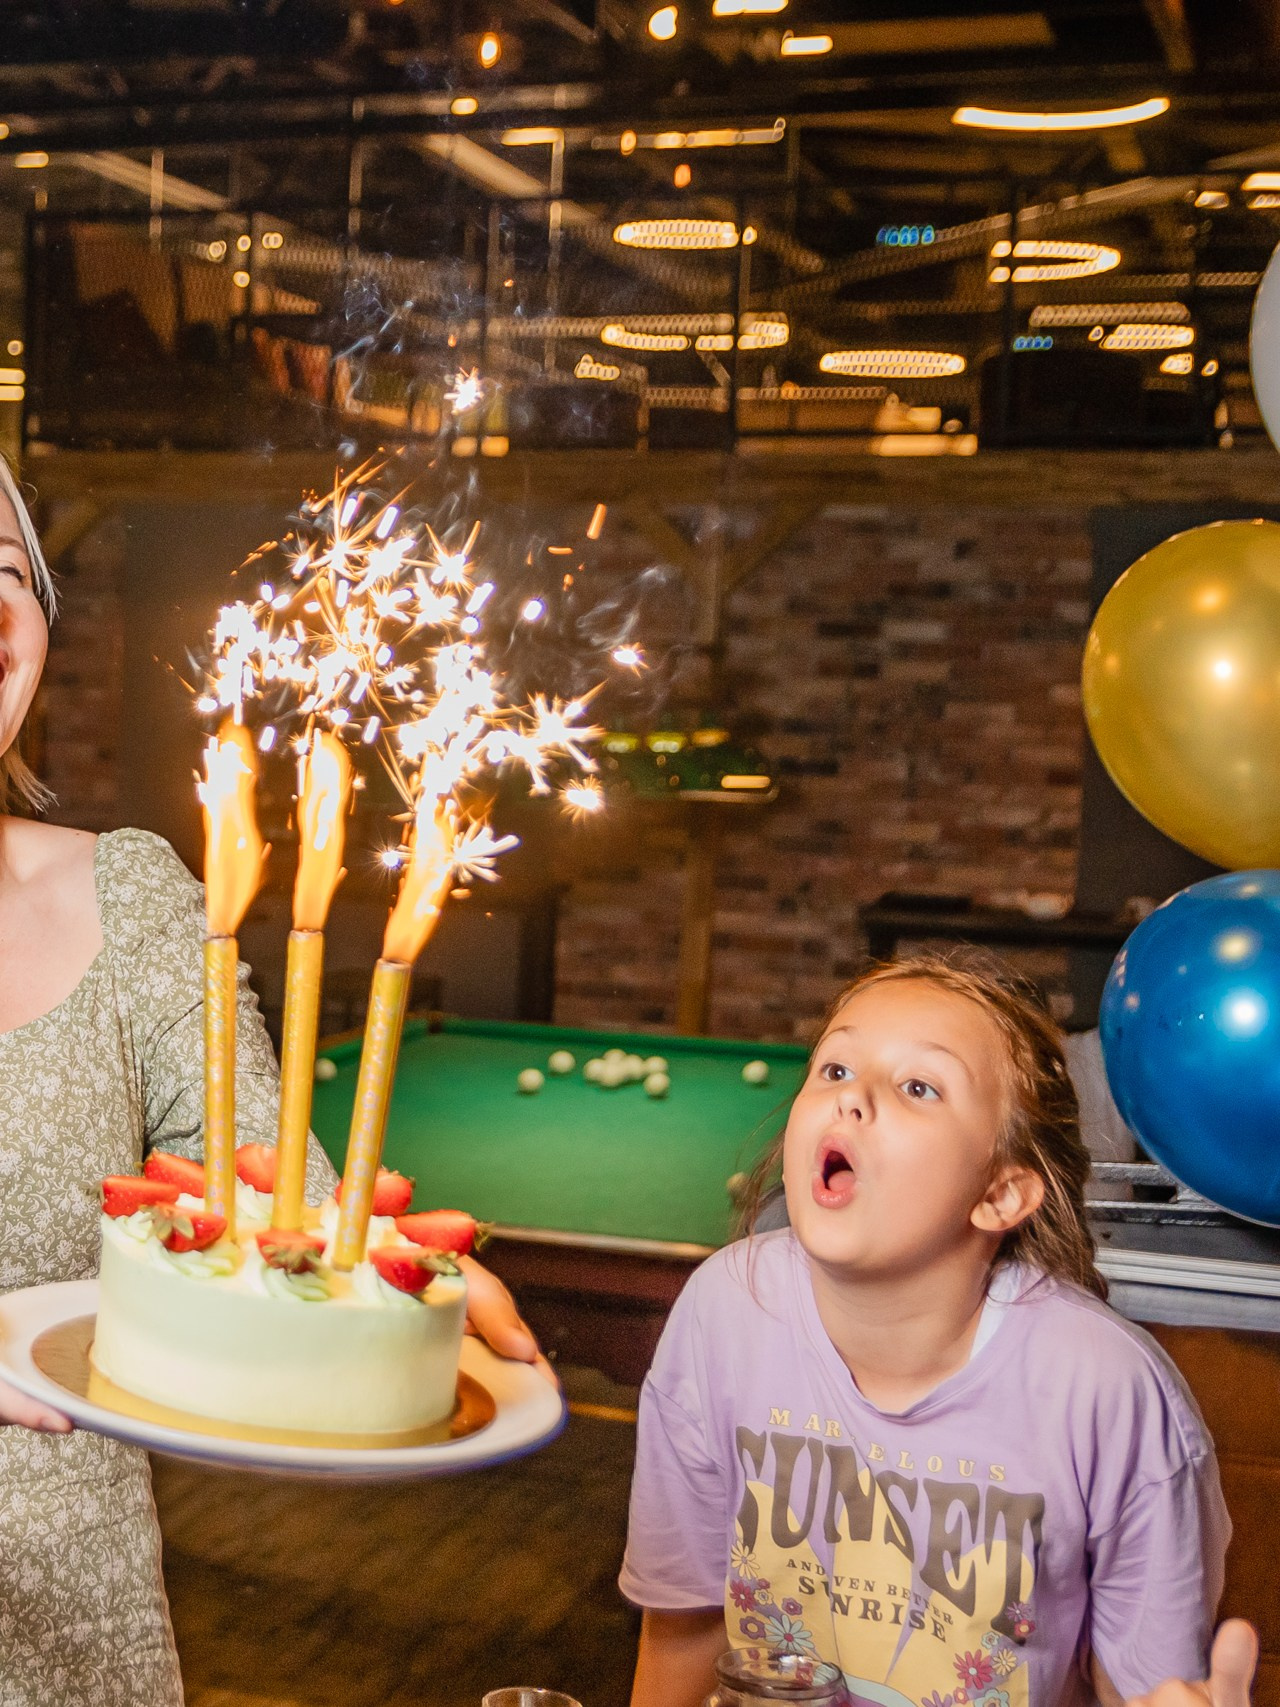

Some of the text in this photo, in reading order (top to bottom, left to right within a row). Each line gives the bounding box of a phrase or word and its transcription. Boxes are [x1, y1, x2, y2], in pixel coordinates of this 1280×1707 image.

[769, 1407, 1006, 1482] MARELOUS
[786, 1558, 826, 1576] AND
[832, 1575, 877, 1593] VEN
